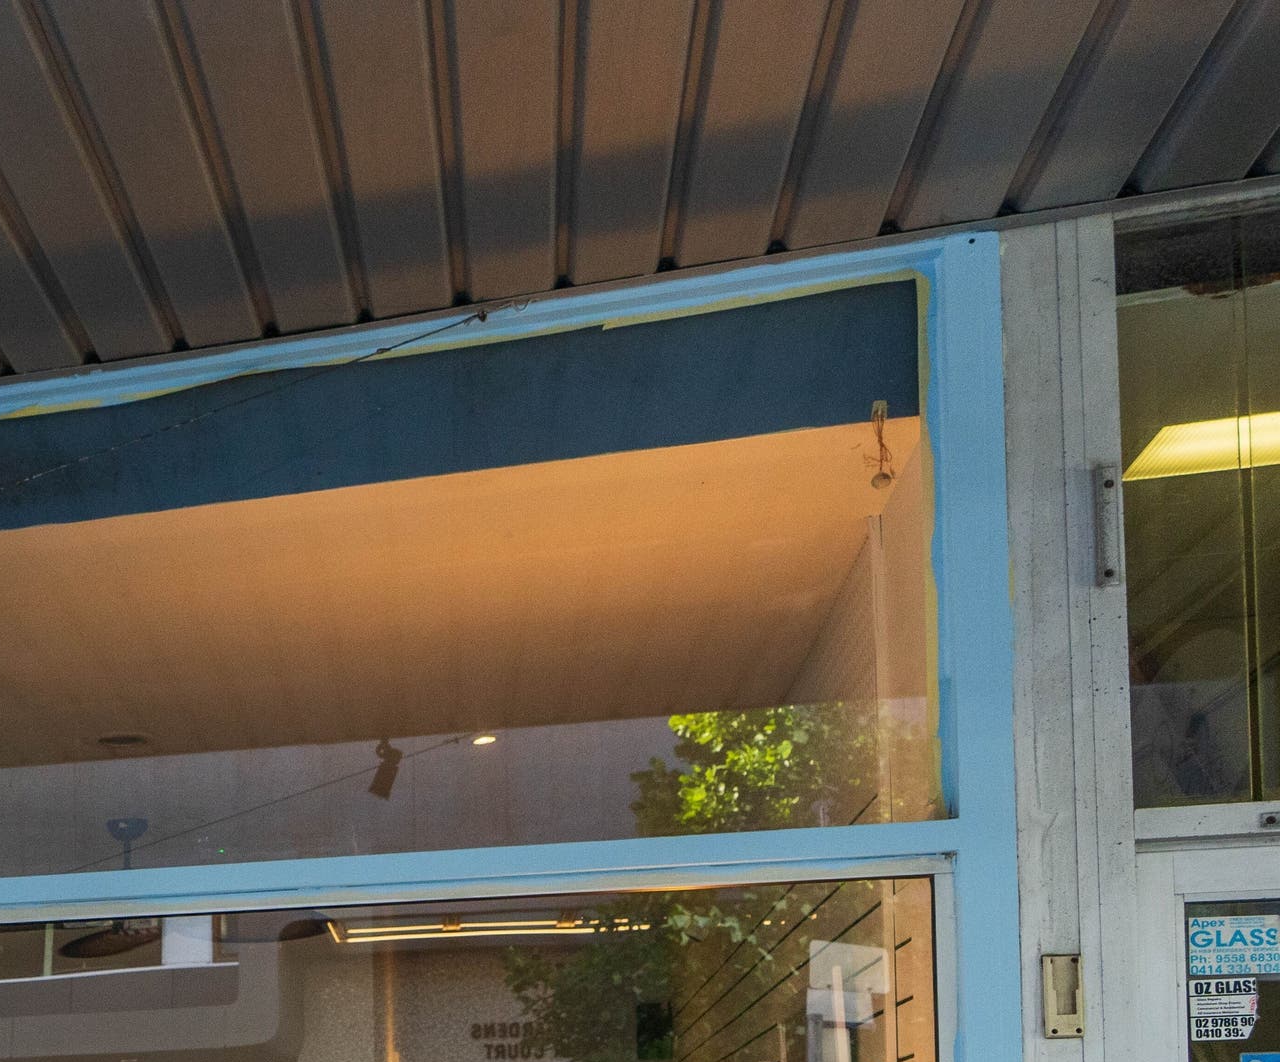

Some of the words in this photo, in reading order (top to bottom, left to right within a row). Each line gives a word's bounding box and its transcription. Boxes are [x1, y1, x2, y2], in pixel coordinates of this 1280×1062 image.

[1190, 919, 1225, 929] Apex
[1190, 928, 1279, 948] GLASS
[1191, 955, 1211, 963] Ph:
[1216, 954, 1245, 962] 9558
[1250, 953, 1280, 962] 6830
[1191, 965, 1223, 975] 0414
[1227, 964, 1251, 974] 336
[1195, 981, 1212, 994] OZ
[1196, 1018, 1211, 1028] 02
[1211, 1018, 1238, 1027] 9786
[1196, 1029, 1222, 1038] 0410
